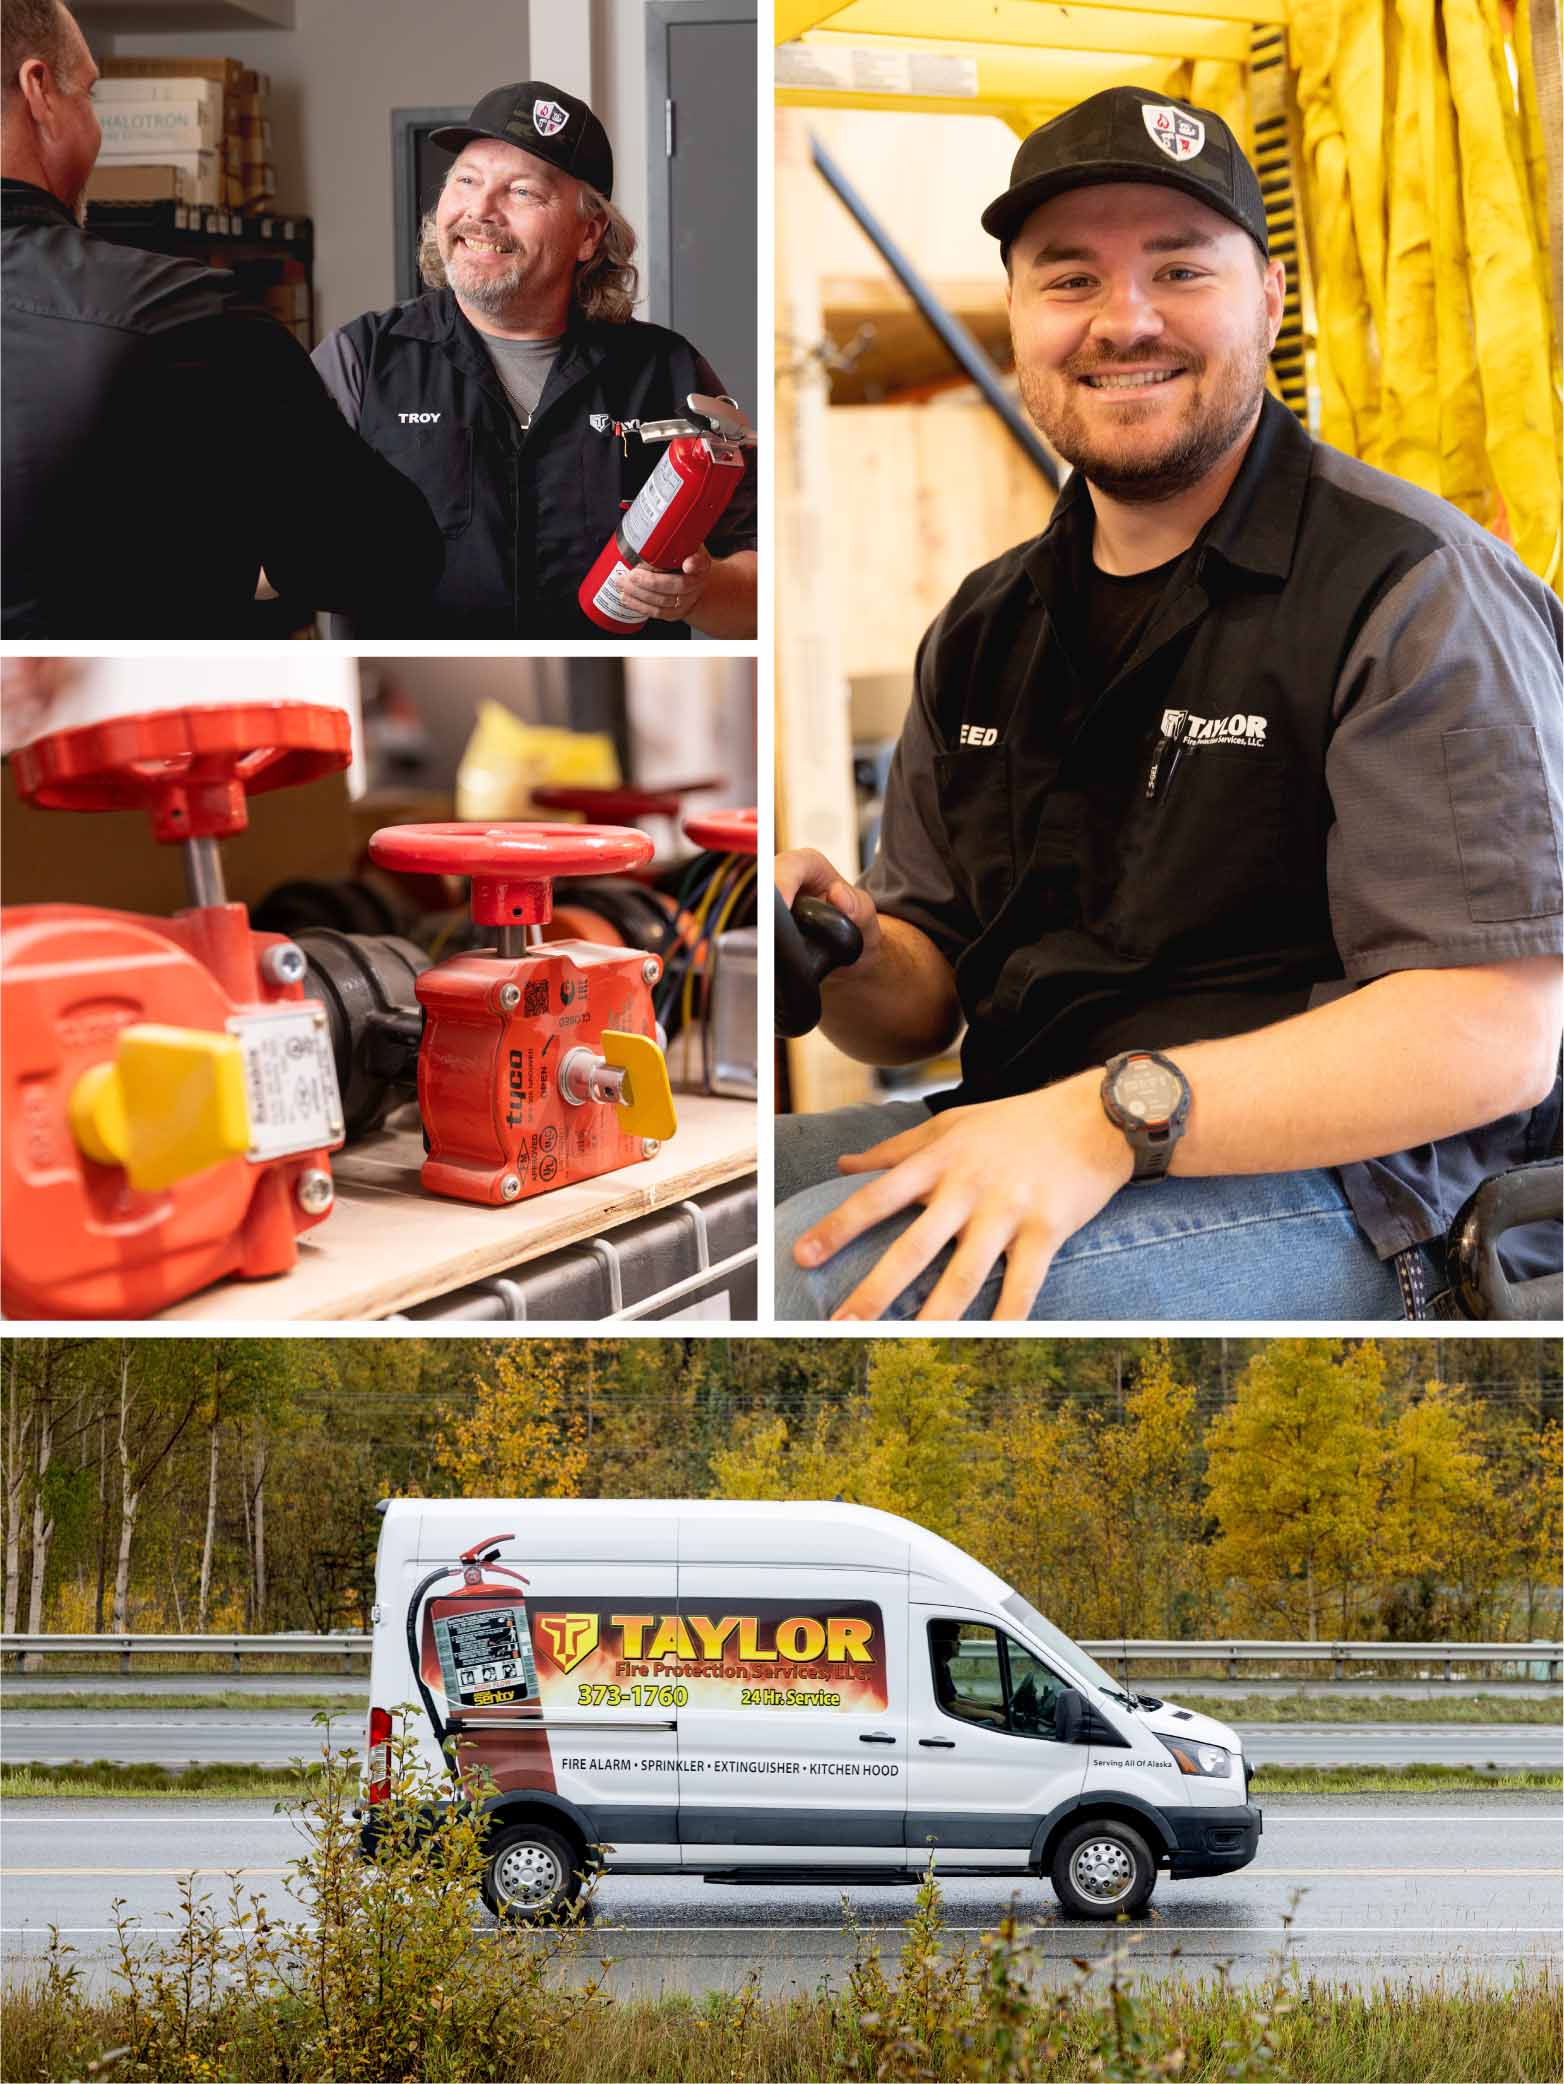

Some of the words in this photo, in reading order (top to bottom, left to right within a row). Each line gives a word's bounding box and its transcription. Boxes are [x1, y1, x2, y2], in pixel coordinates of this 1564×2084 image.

[398, 412, 441, 424] TROY
[1187, 713, 1268, 739] TAYLOR
[1218, 735, 1247, 746] Services,
[1247, 736, 1265, 748] LLC.
[506, 1049, 526, 1129] tyco
[610, 1614, 875, 1664] TAYLOR
[615, 1660, 650, 1677] Fire
[653, 1661, 748, 1679] Protection
[751, 1663, 831, 1682] Services,
[577, 1683, 689, 1707] 373-1760
[740, 1688, 761, 1706] 24
[763, 1689, 785, 1706] Hr.
[785, 1689, 841, 1707] Service
[561, 1758, 587, 1771] FIRE
[589, 1759, 631, 1771] ALARM
[640, 1759, 704, 1773] SPRINKLER
[714, 1760, 800, 1775] EXTINGUISHER
[809, 1762, 860, 1776] KITCHEN
[862, 1764, 899, 1777] HOOD
[1093, 1758, 1124, 1768] Serving
[1124, 1759, 1136, 1767] All
[1136, 1759, 1147, 1767] Of
[1148, 1759, 1173, 1768] Alaska
